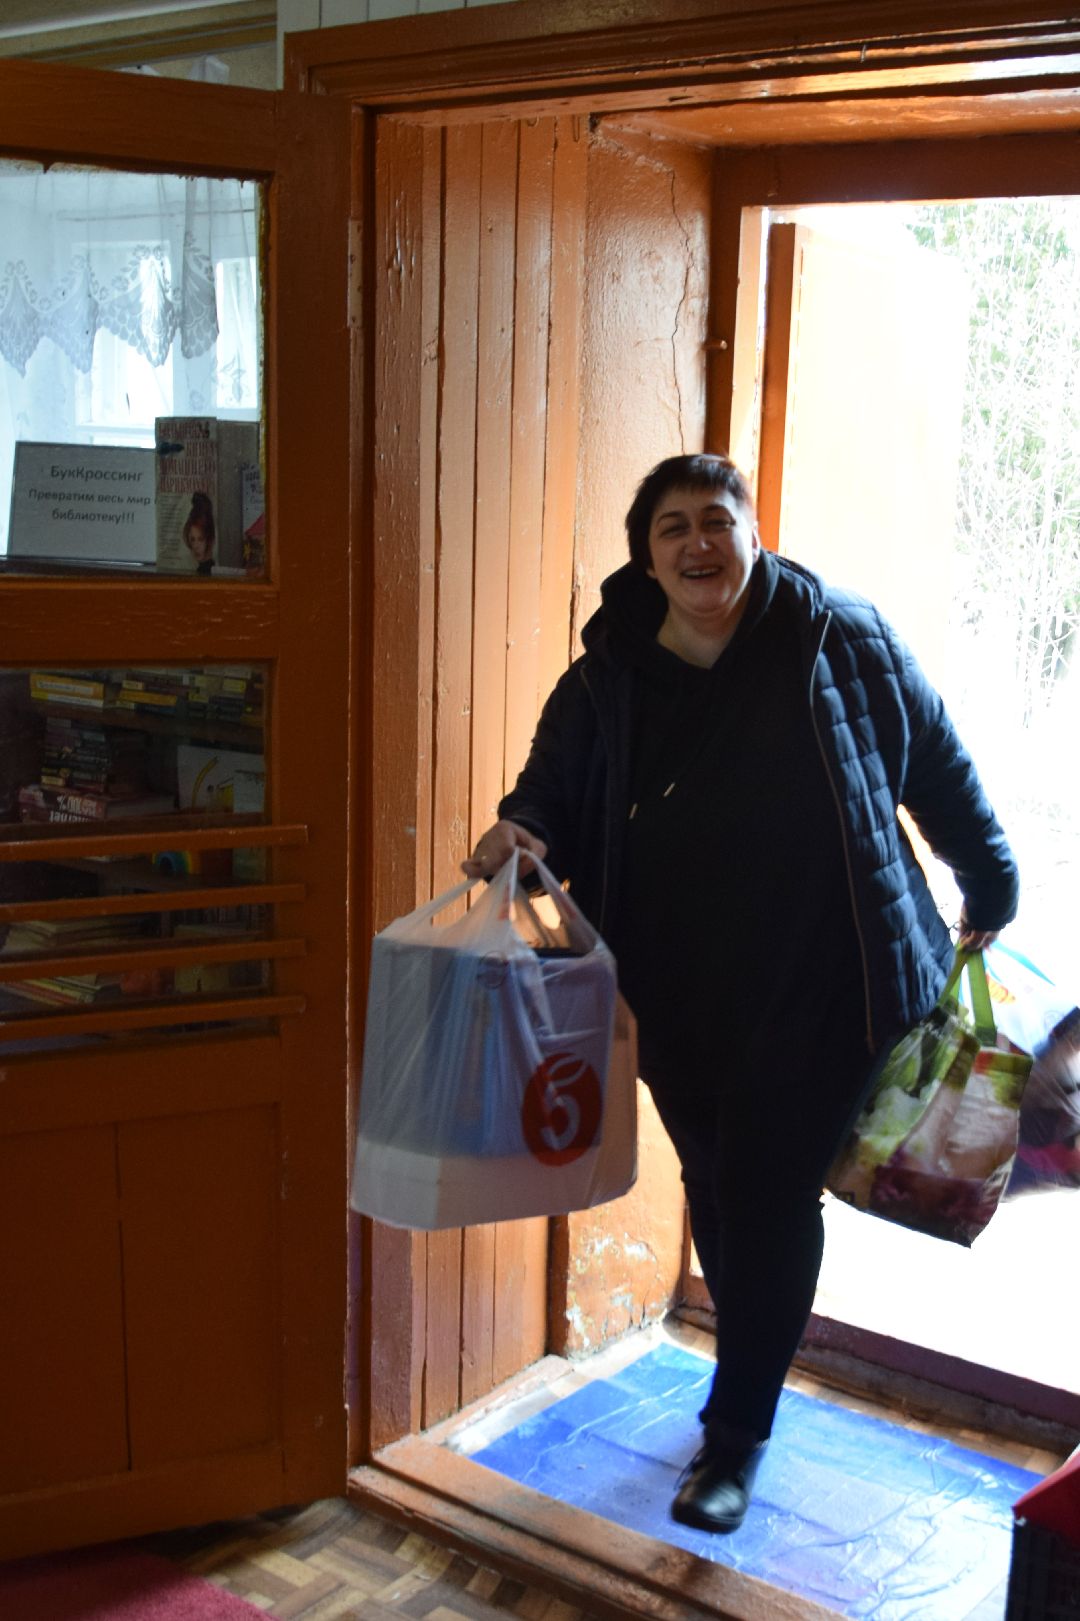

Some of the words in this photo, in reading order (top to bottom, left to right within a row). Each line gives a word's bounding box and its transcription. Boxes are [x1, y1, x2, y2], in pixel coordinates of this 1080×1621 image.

[50, 465, 144, 482] БукКроссинг
[28, 488, 95, 503] Превратим
[97, 493, 124, 503] весь
[126, 496, 151, 506] мир
[51, 508, 135, 525] библиотеку!!!
